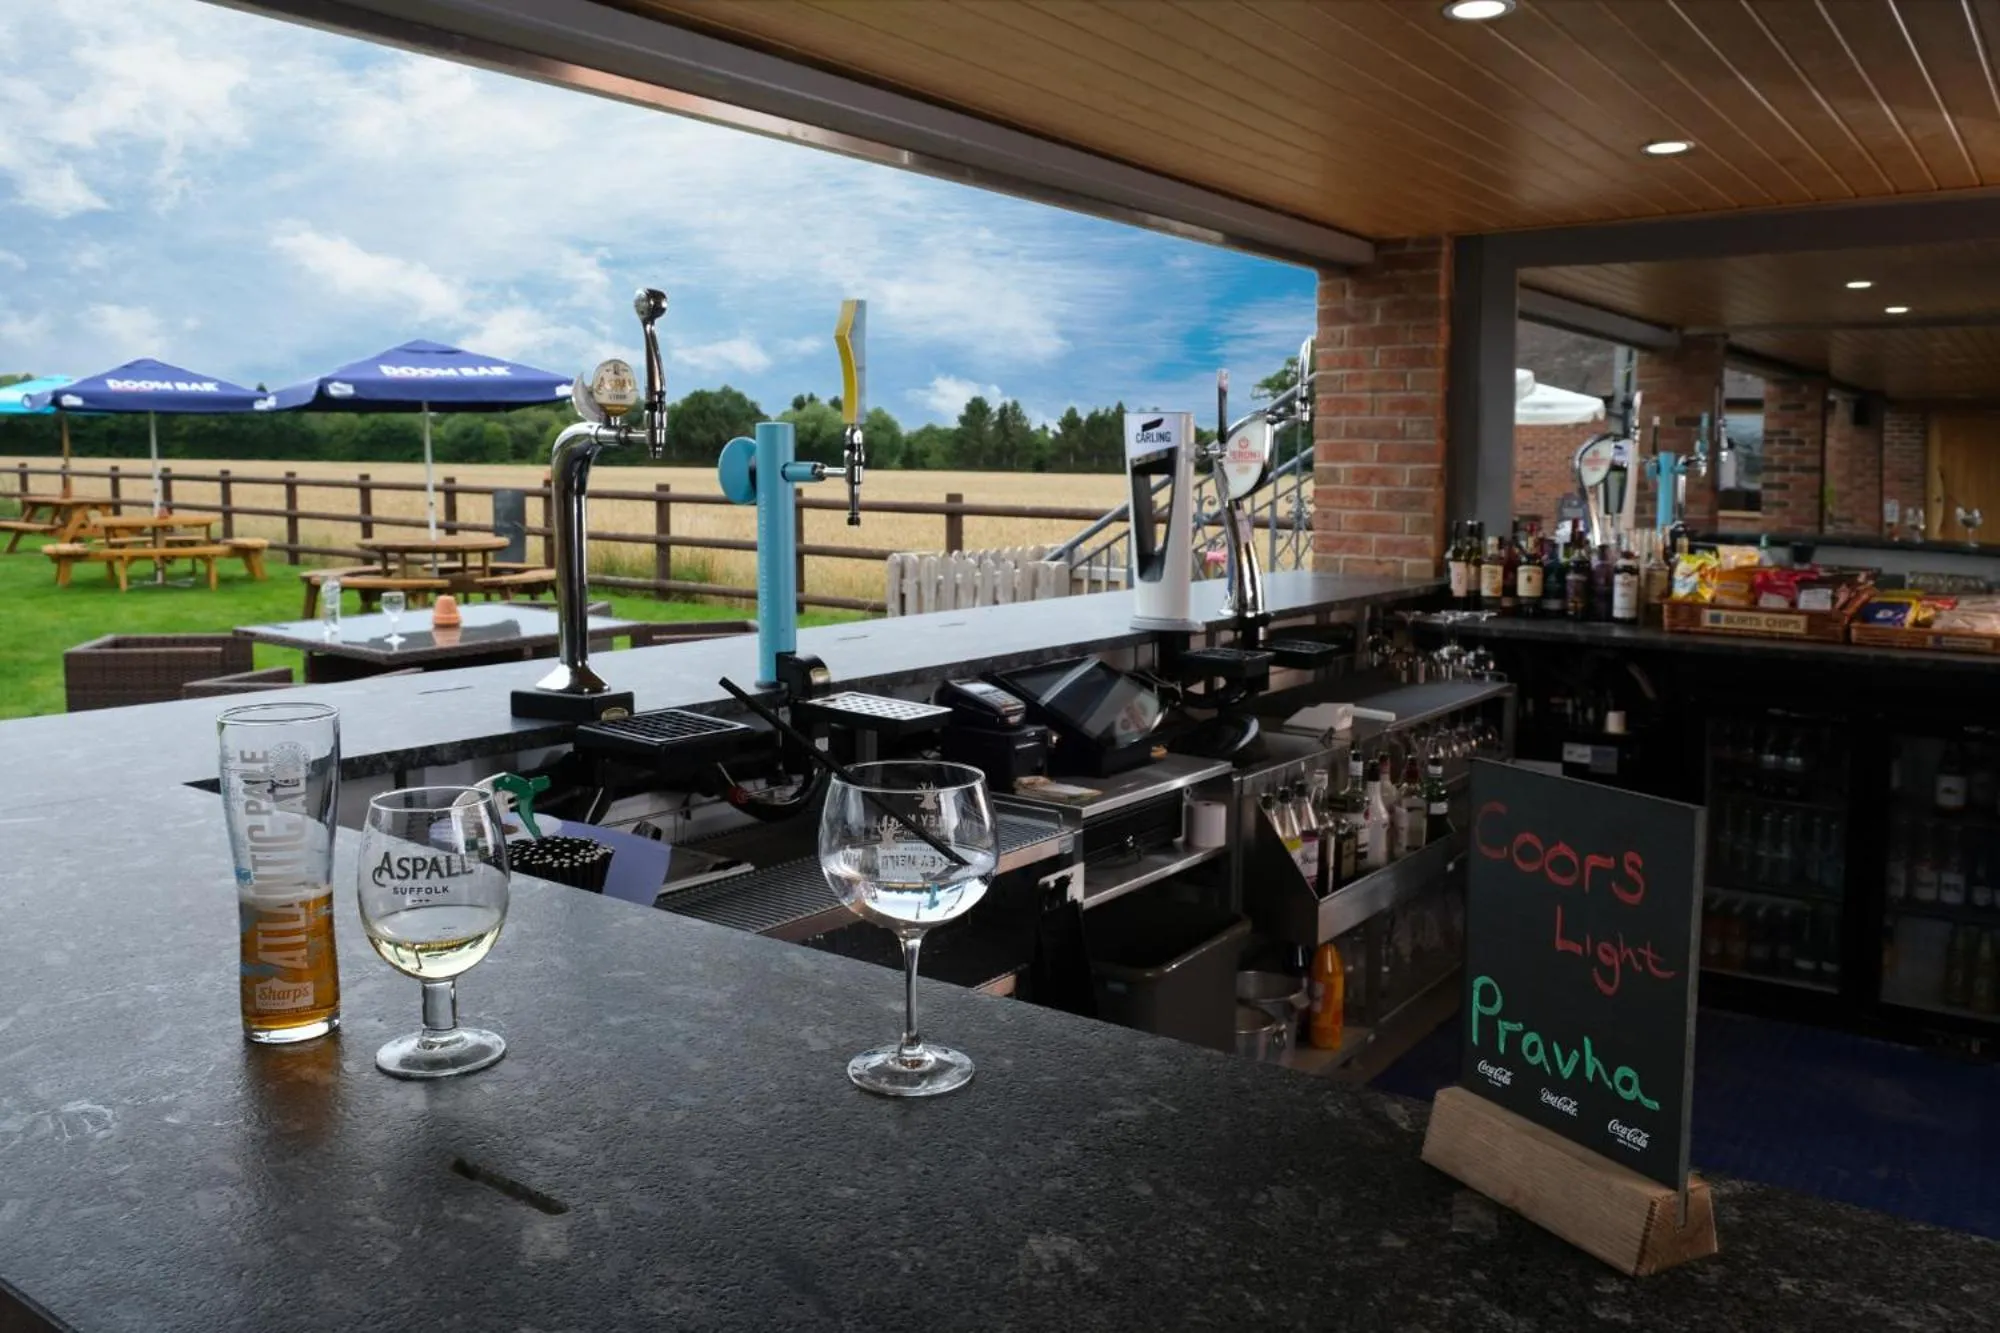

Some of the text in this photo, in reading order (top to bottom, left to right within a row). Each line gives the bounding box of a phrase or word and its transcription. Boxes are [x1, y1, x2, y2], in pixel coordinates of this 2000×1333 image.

[378, 364, 513, 378] DOOM BAR
[105, 379, 219, 392] DOOM BAR
[1135, 431, 1171, 444] CARLING
[1474, 801, 1646, 906] Coors
[371, 851, 474, 888] ASPALL
[392, 885, 449, 896] SUFFOLK
[1555, 905, 1676, 996] Light
[1472, 975, 1661, 1111] Pravha
